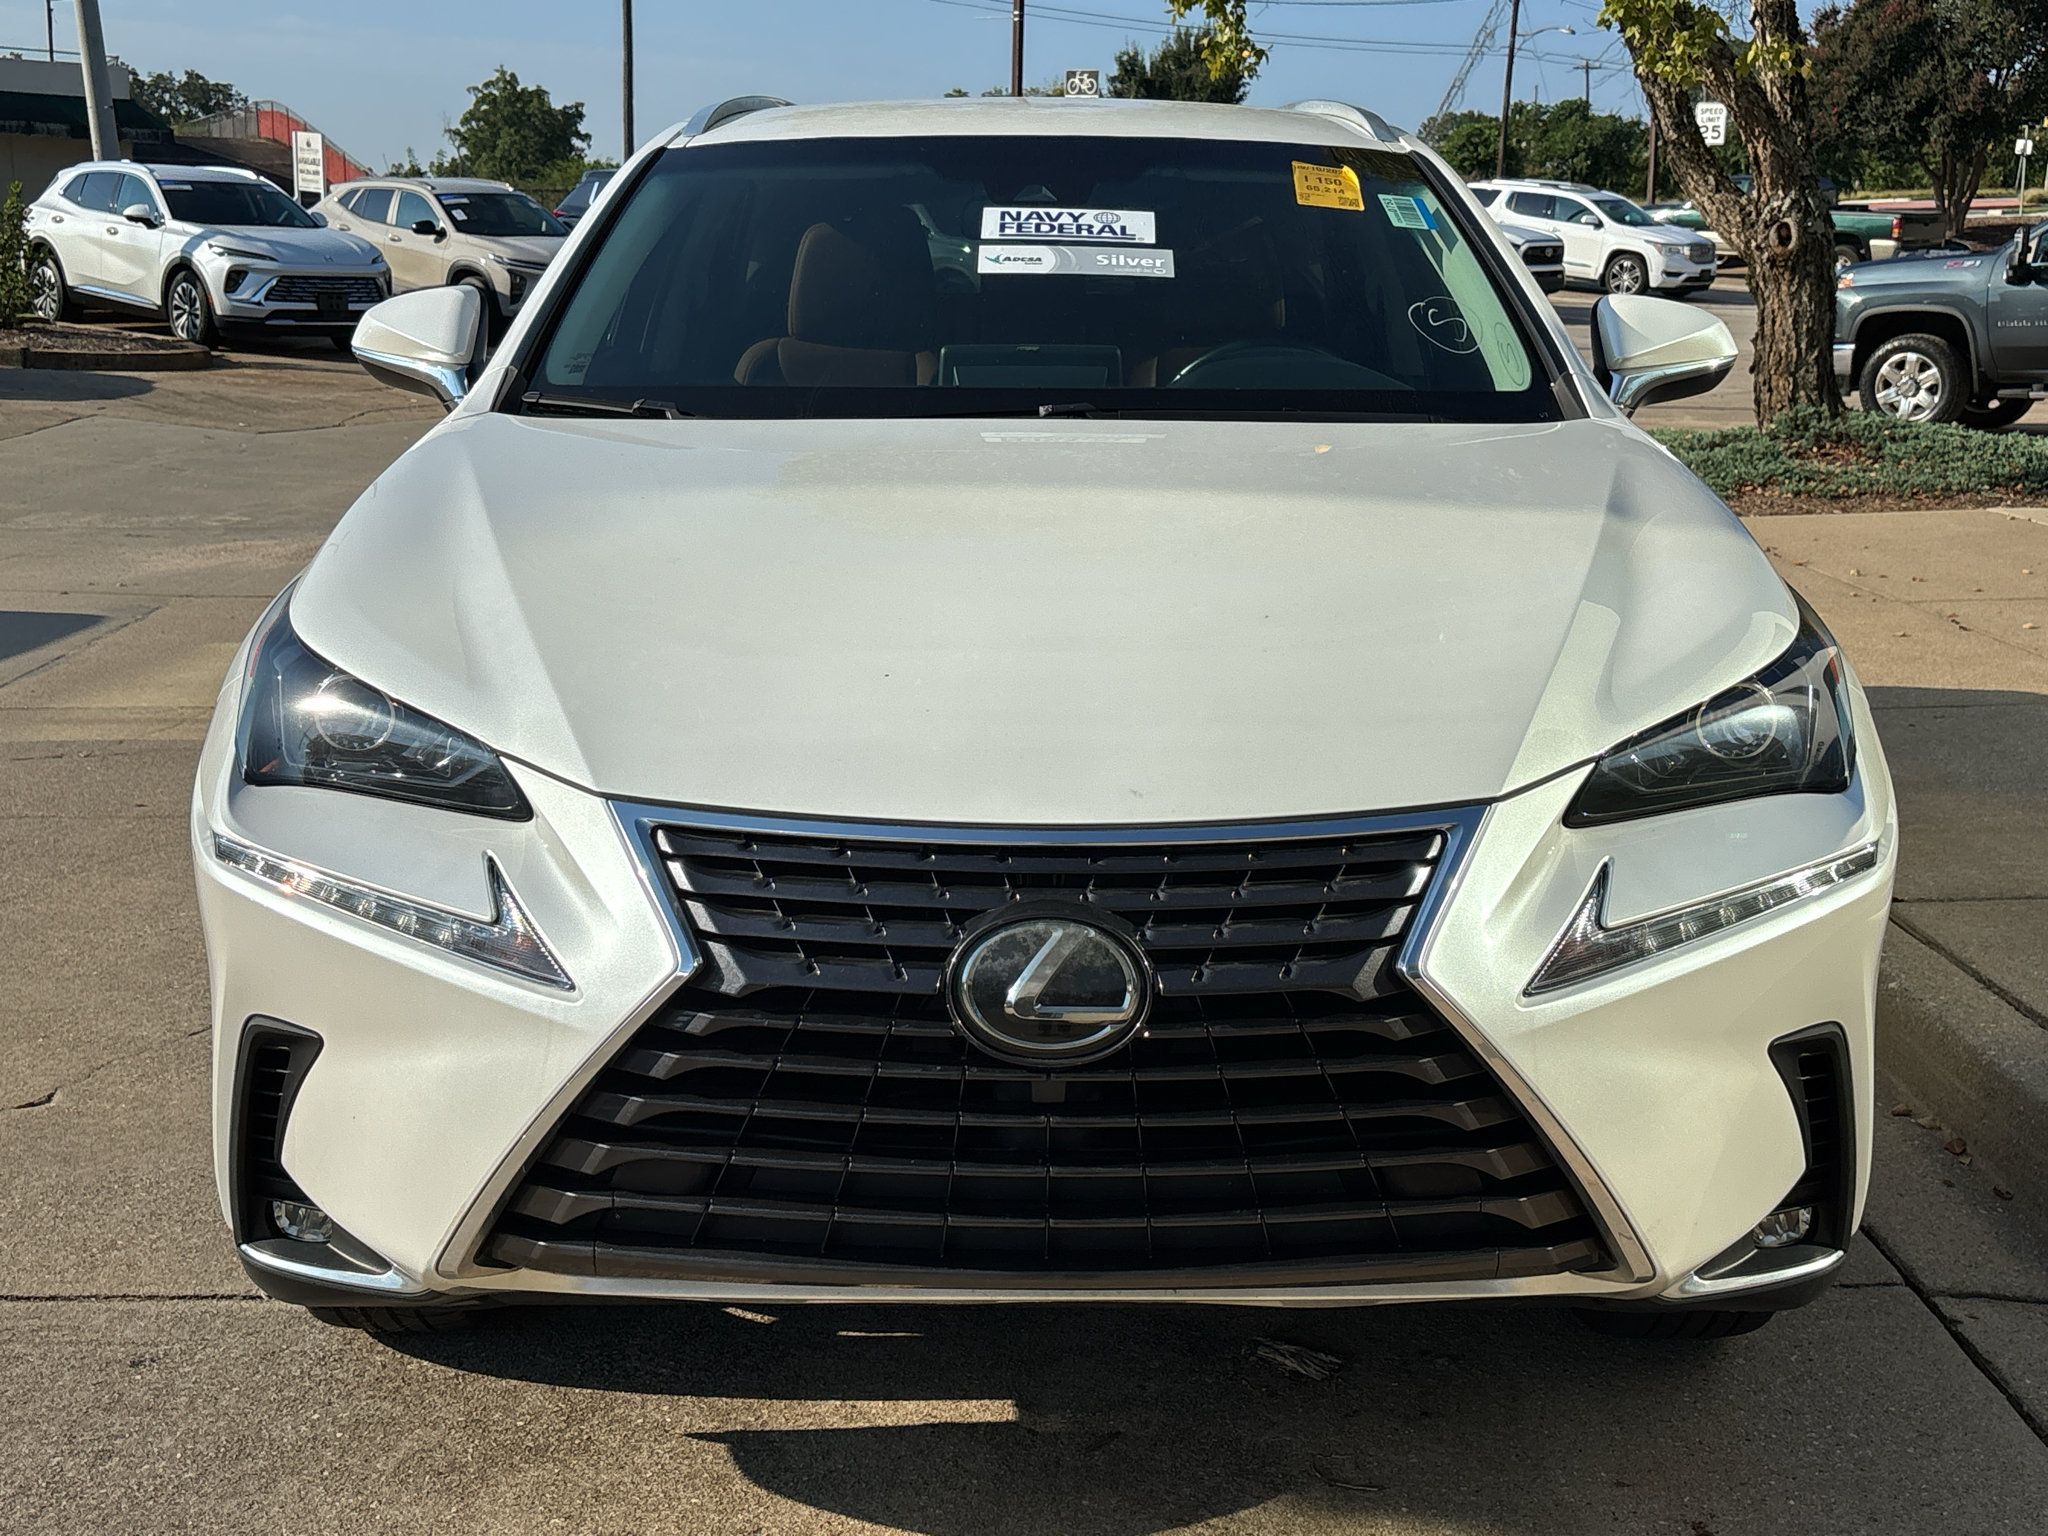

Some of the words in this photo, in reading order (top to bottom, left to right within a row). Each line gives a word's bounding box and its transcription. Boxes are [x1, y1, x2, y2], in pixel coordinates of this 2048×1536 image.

[1701, 107, 1723, 115] SPEED
[1700, 125, 1721, 139] 25
[1000, 210, 1087, 223] NAVY
[999, 222, 1137, 237] FEDERAL
[1096, 254, 1165, 267] Silver
